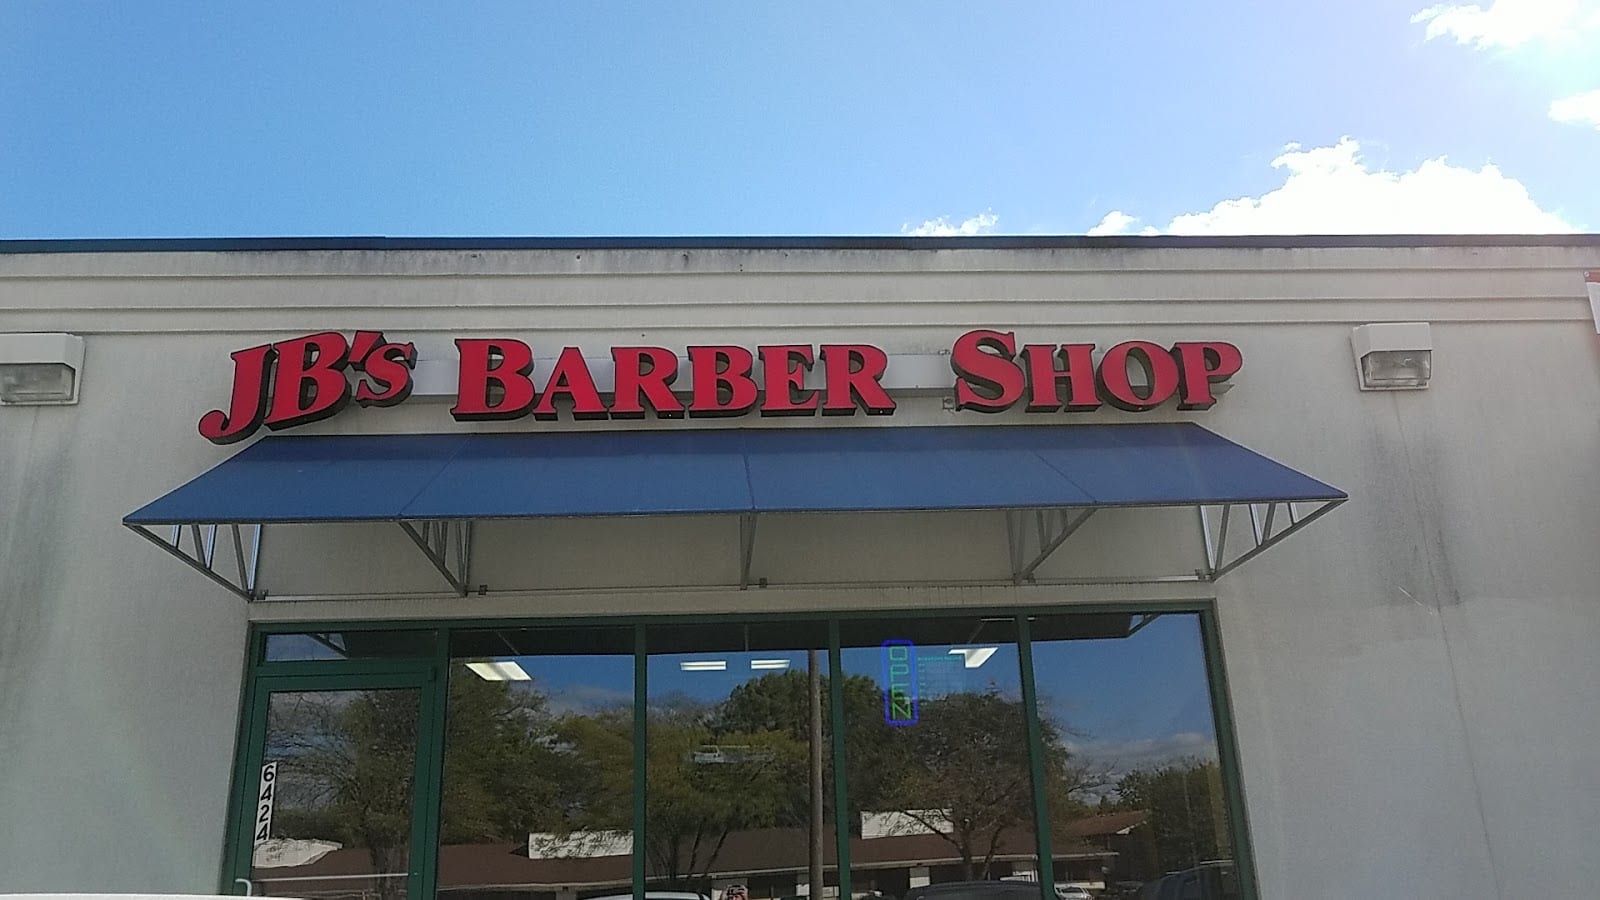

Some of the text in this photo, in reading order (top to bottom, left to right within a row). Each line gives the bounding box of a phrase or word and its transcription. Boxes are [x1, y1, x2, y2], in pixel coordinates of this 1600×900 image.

[451, 338, 895, 421] BARBER
[951, 329, 1243, 413] SHOP
[889, 645, 912, 720] OPEN
[256, 764, 275, 841] 6424
